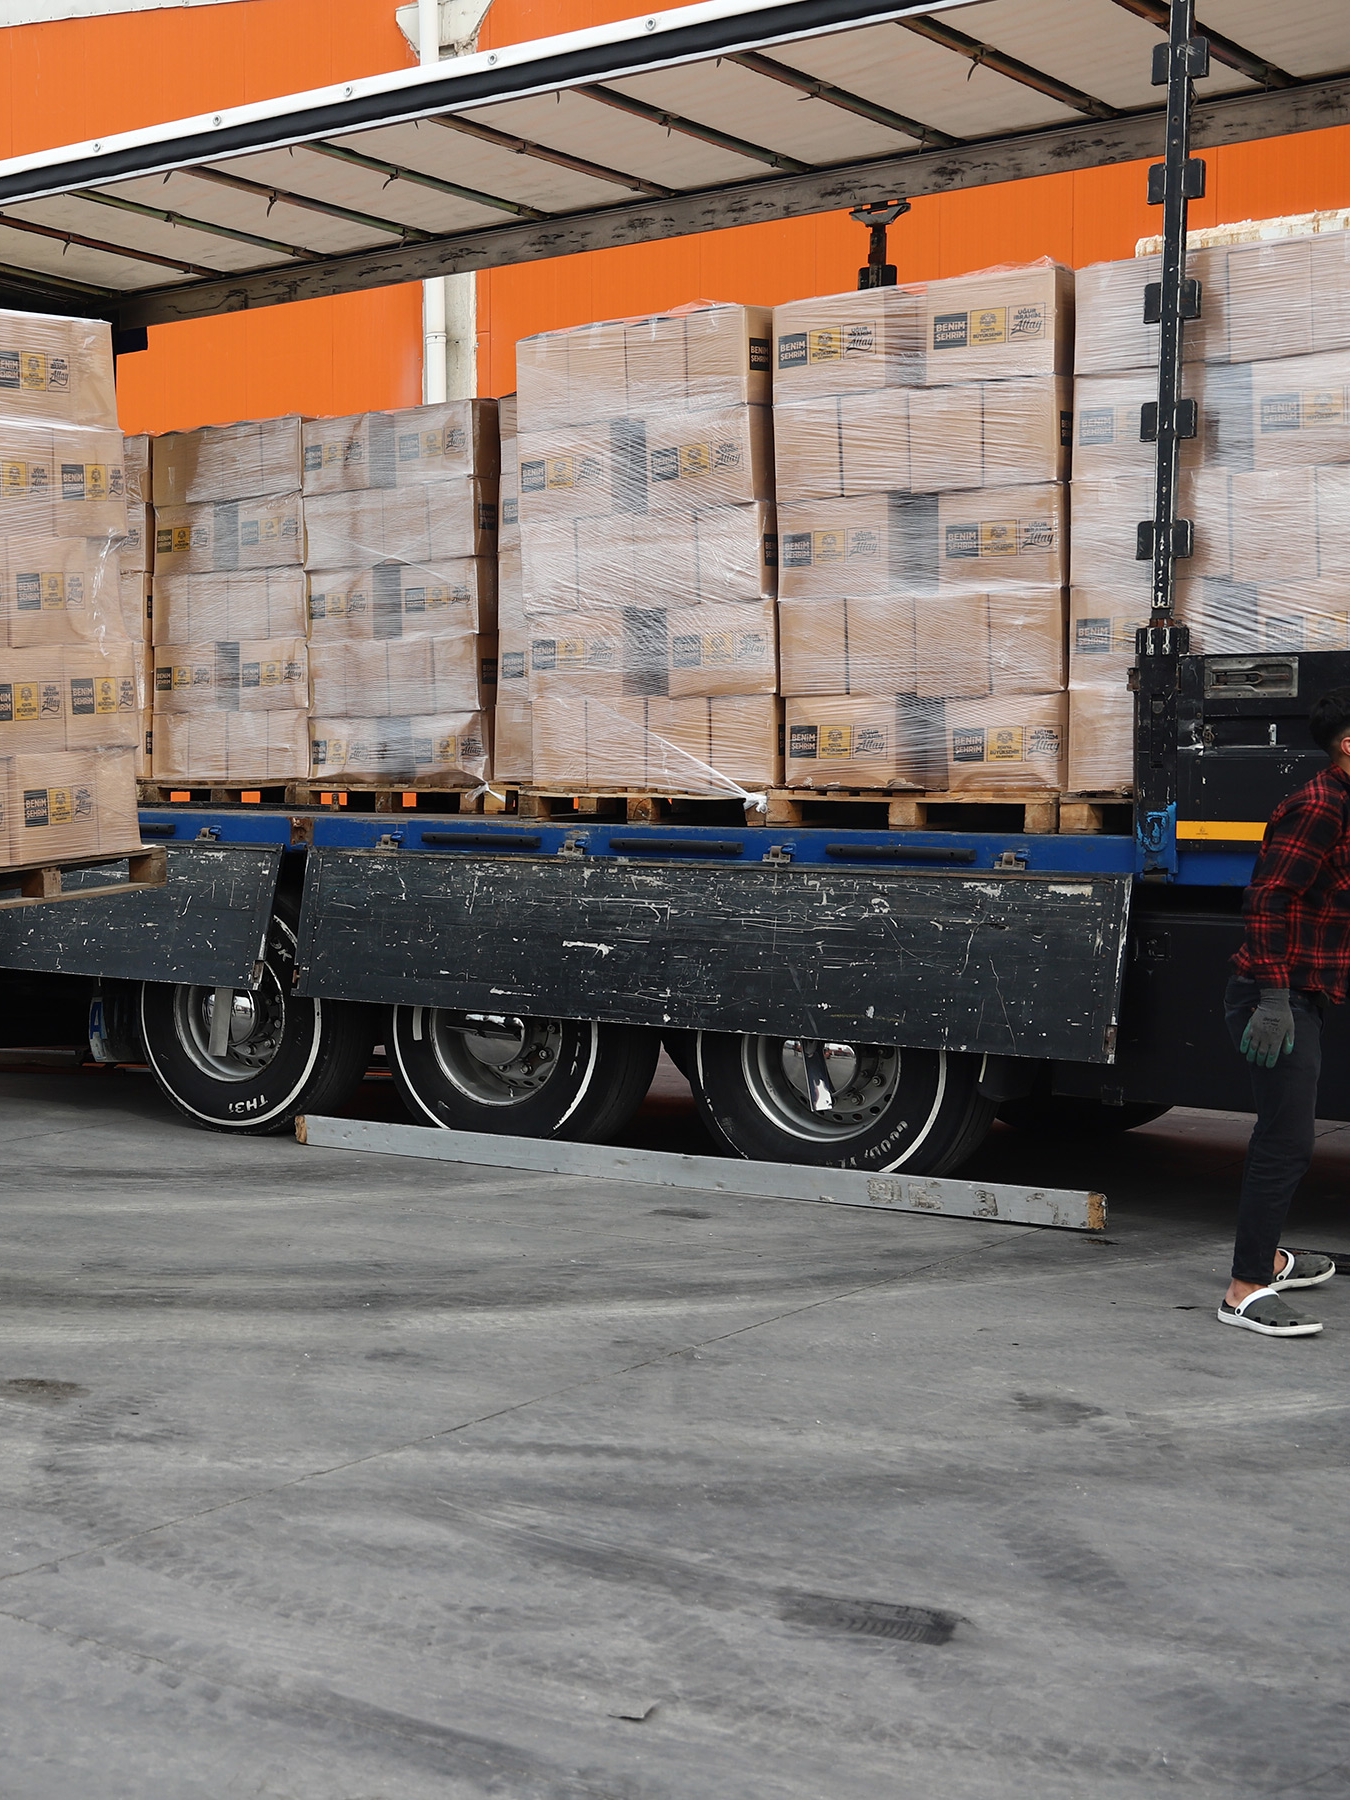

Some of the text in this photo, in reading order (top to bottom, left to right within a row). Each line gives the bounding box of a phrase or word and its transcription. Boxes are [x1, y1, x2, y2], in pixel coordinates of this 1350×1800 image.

[1010, 320, 1042, 335] Altay
[1022, 533, 1053, 548] Altay
[1028, 740, 1059, 754] Altay
